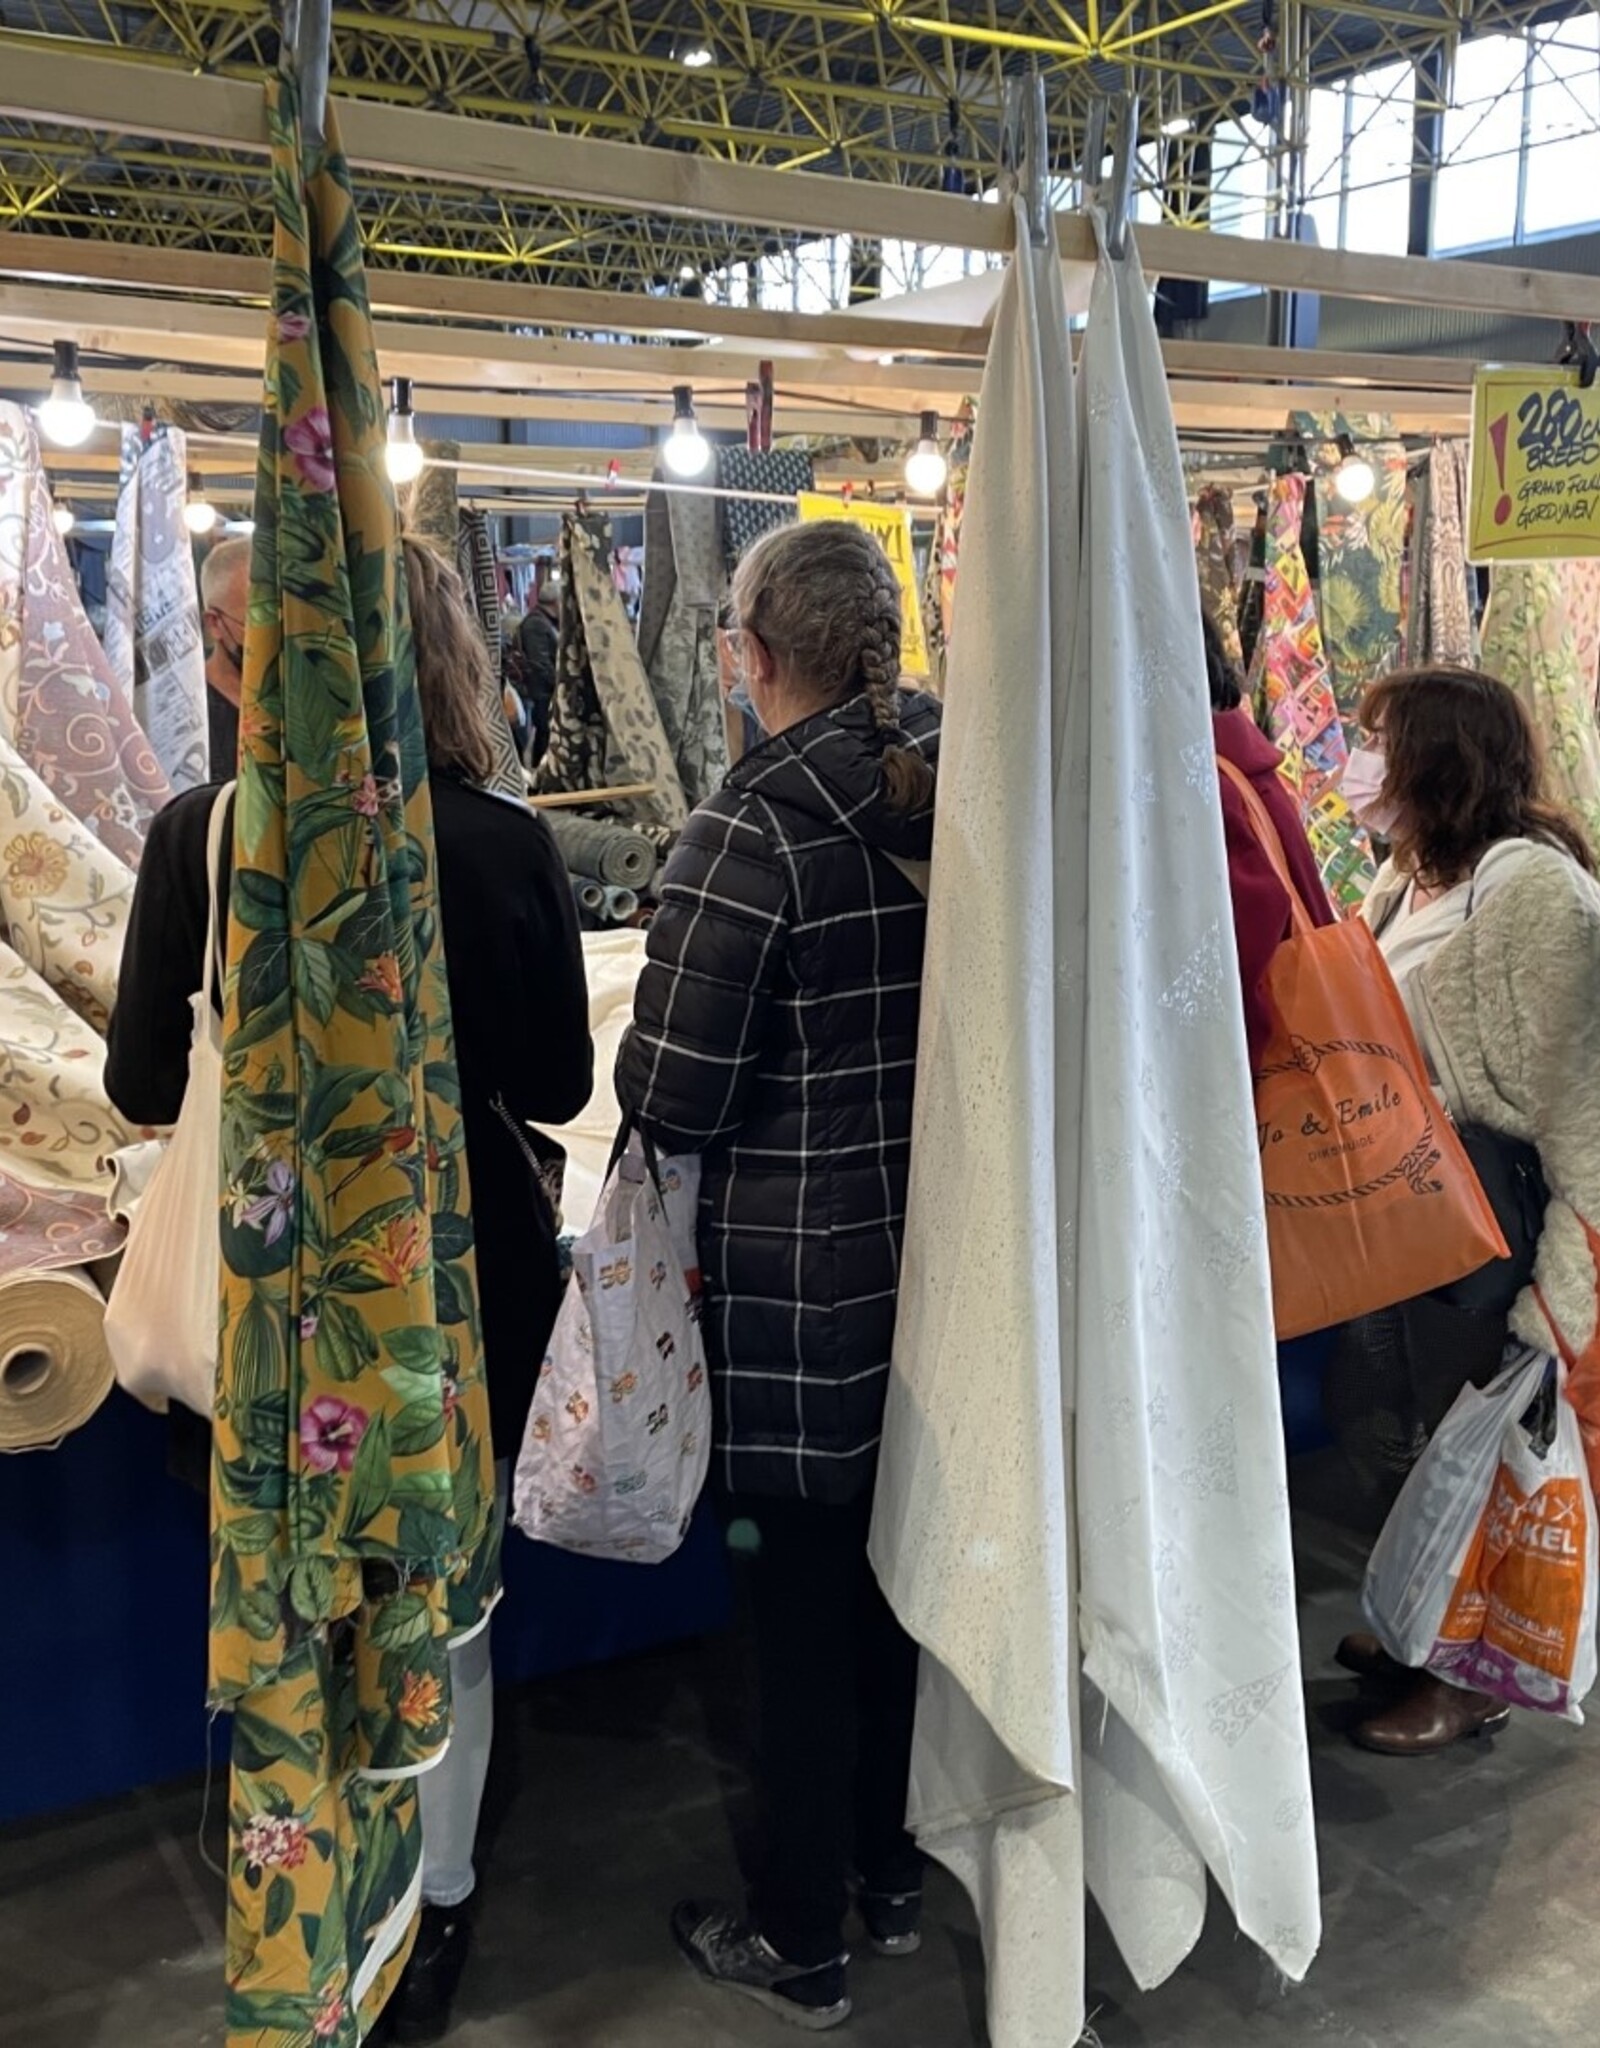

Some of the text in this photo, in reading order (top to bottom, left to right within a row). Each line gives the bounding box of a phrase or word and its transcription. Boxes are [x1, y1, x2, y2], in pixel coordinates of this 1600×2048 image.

[1517, 388, 1582, 451] 280
[1526, 443, 1600, 472] BREED
[1516, 478, 1565, 503] GRAND
[1301, 1112, 1328, 1136] &
[1335, 1083, 1401, 1125] Emile
